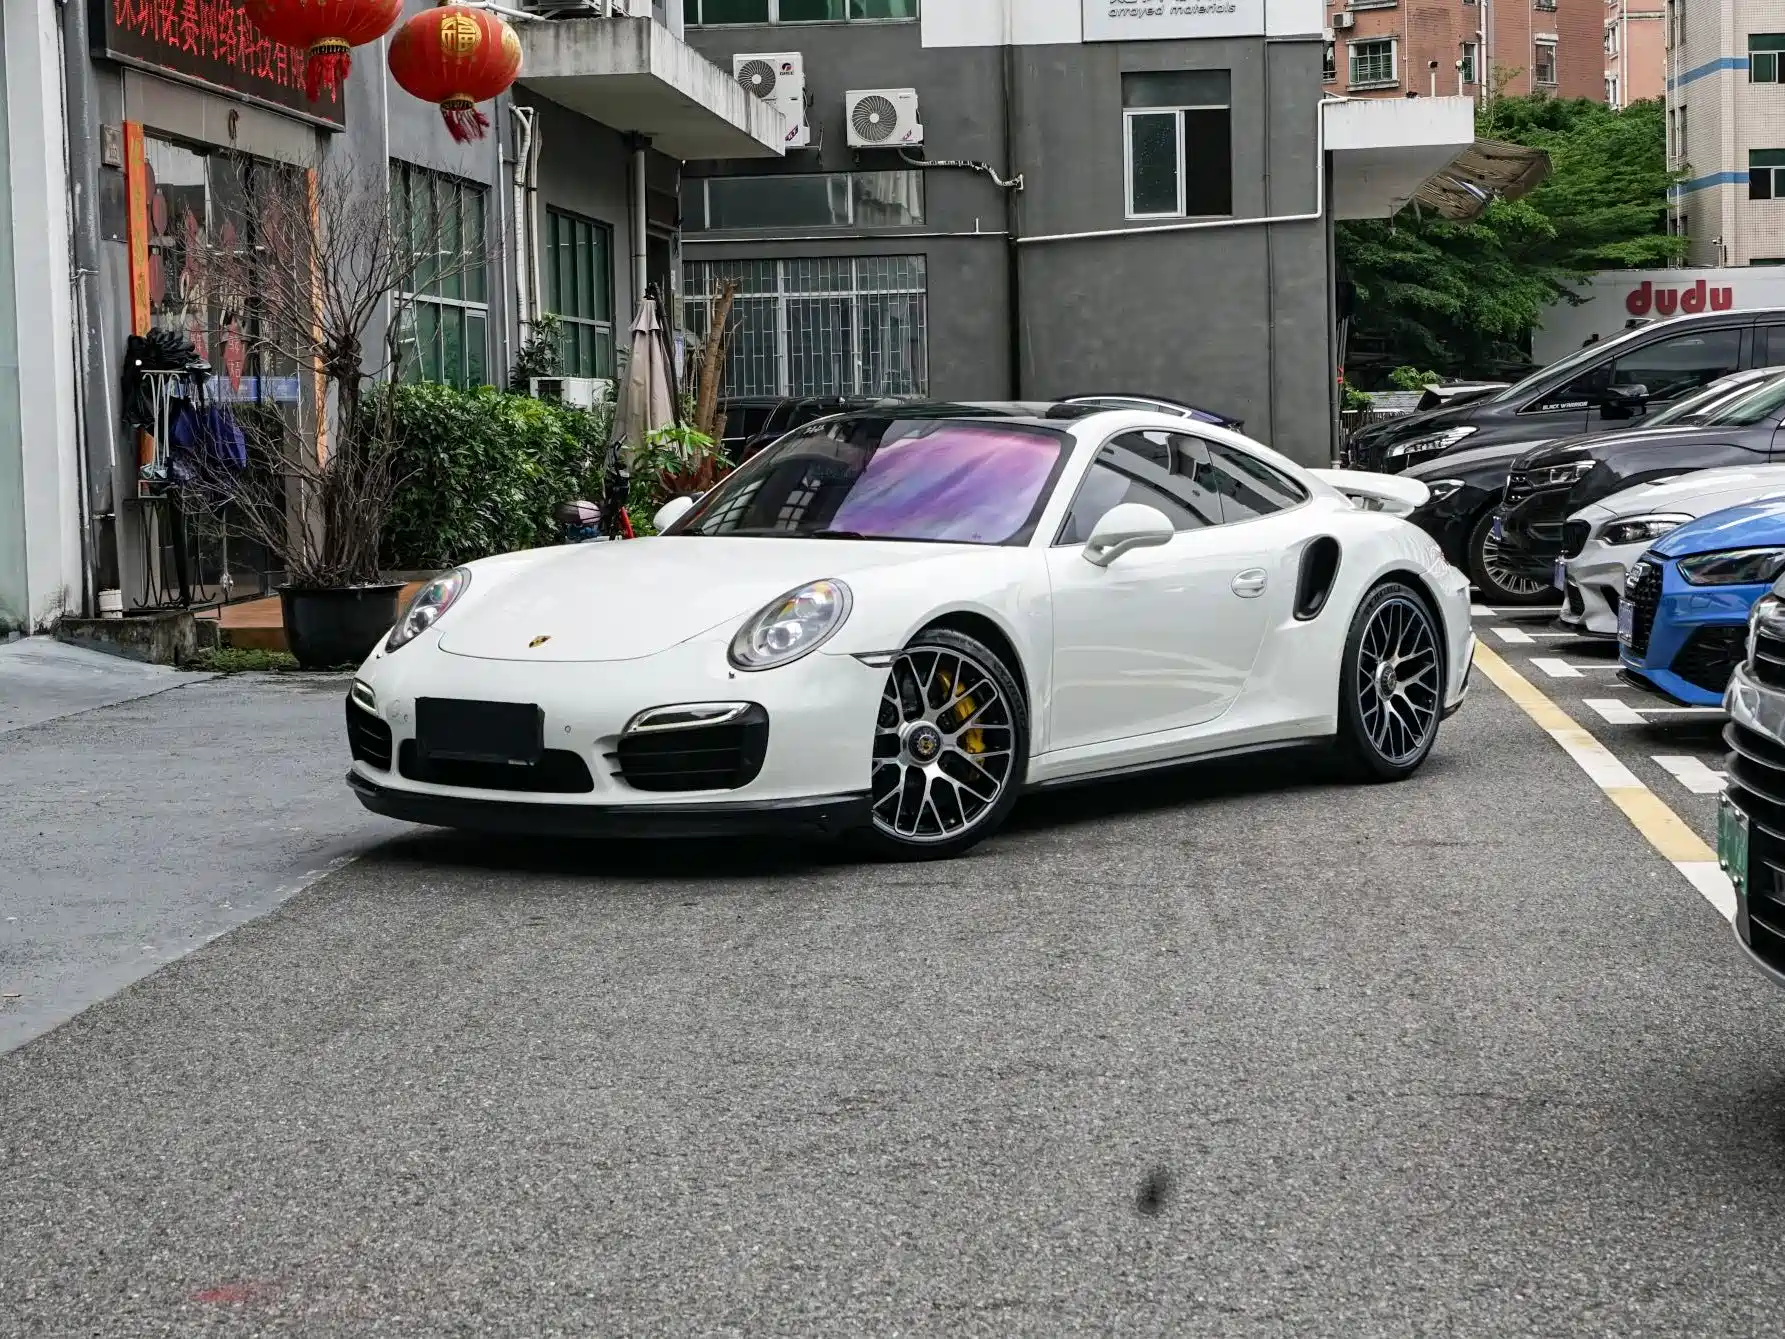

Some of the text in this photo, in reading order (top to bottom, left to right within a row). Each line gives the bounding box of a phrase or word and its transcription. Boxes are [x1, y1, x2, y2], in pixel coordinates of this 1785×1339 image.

[1108, 4, 1236, 18] arrayed materials
[441, 12, 482, 57] 福
[1626, 280, 1732, 315] dudu
